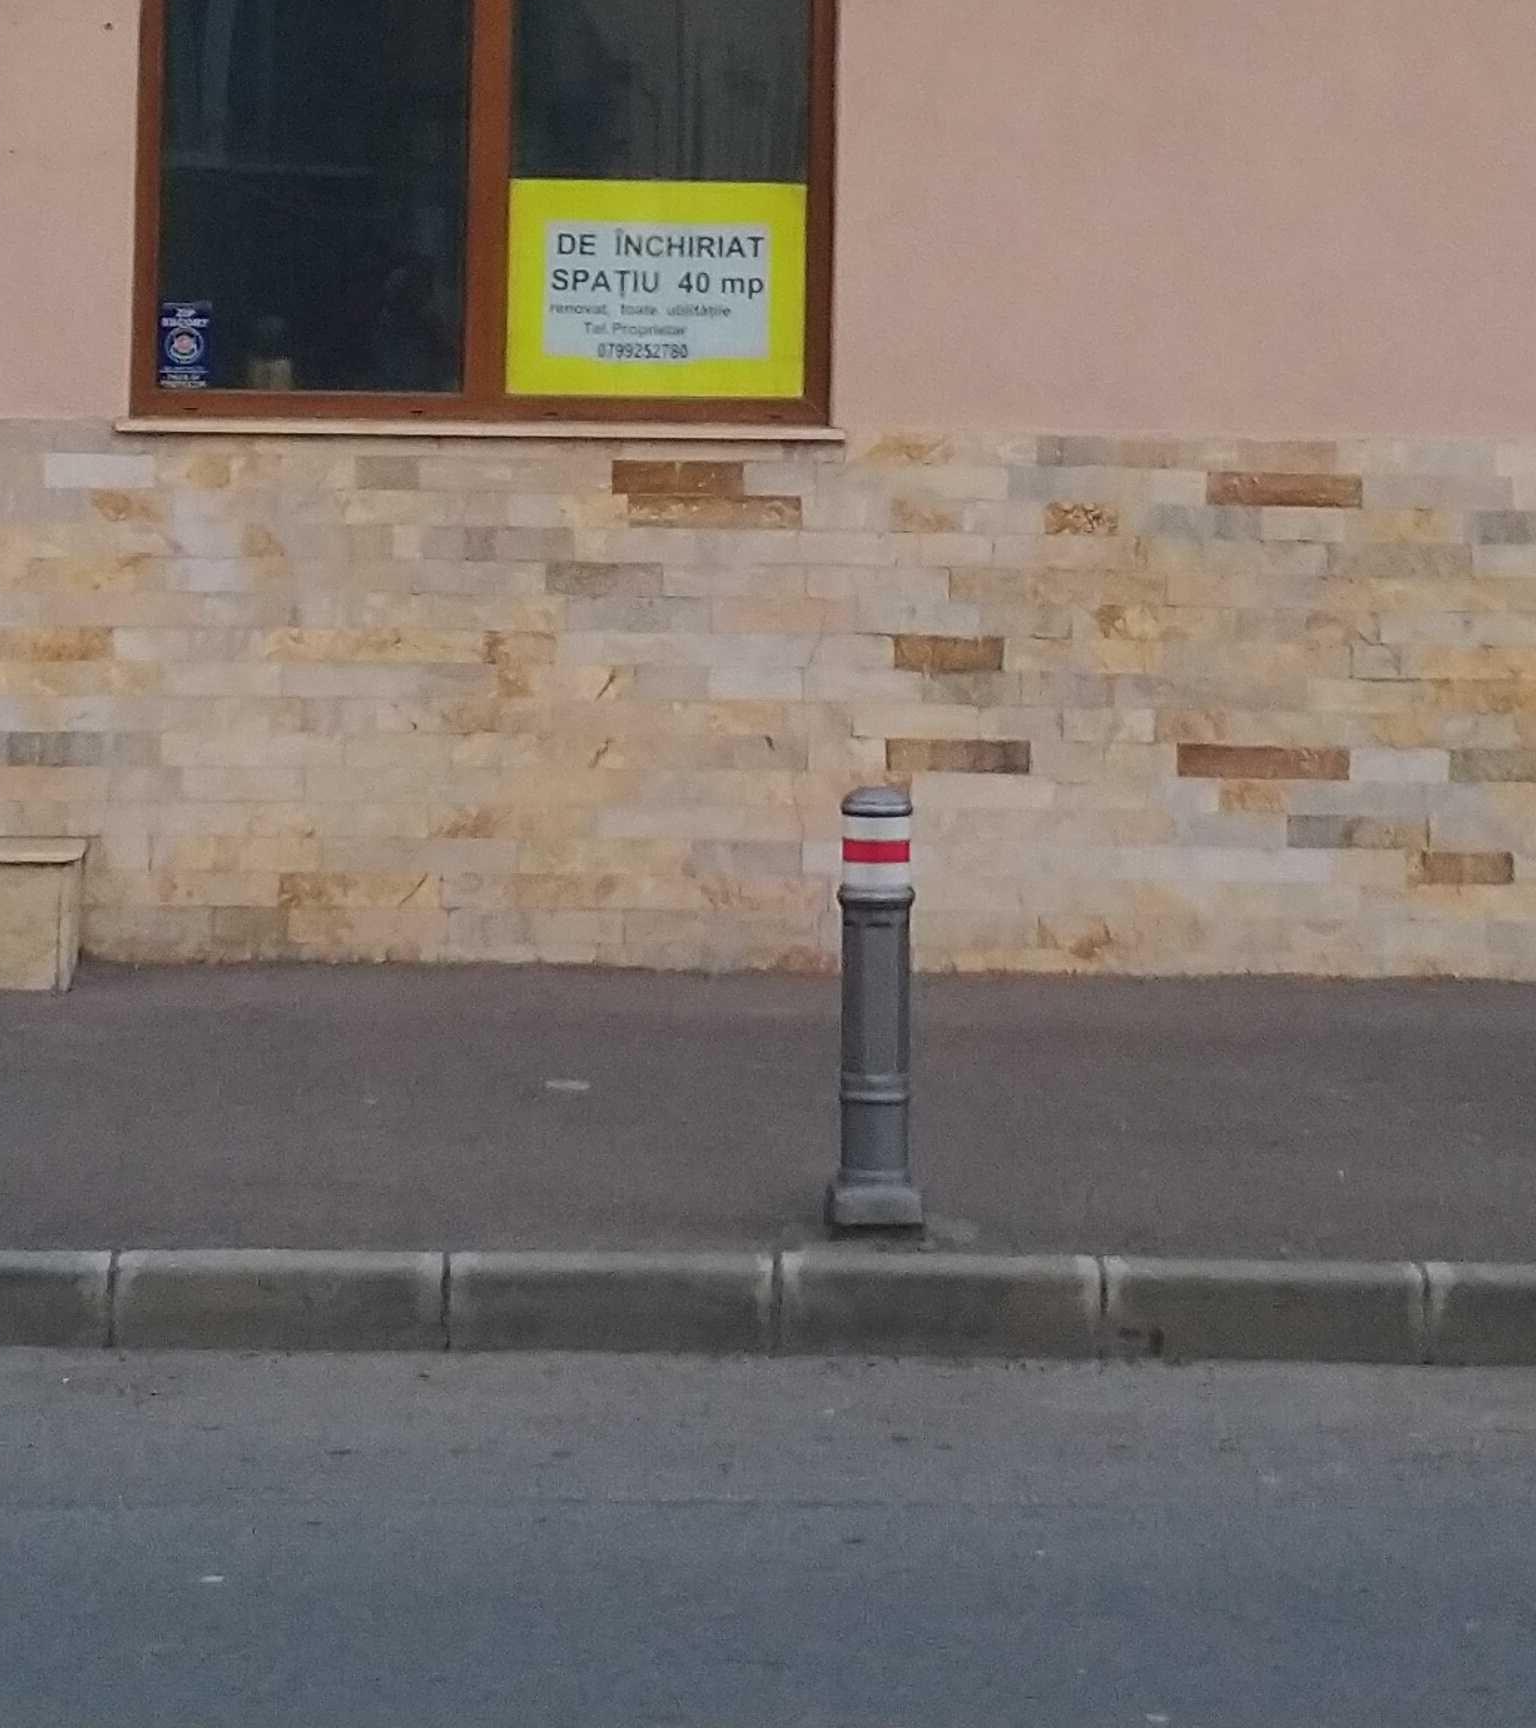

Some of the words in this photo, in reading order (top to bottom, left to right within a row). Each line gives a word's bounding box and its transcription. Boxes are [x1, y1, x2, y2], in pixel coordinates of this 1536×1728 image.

[557, 233, 597, 256] DE
[615, 228, 765, 258] ÎNCHIRIAT
[551, 268, 659, 297] SPAȚIU
[678, 272, 710, 294] 40
[721, 276, 764, 300] mp
